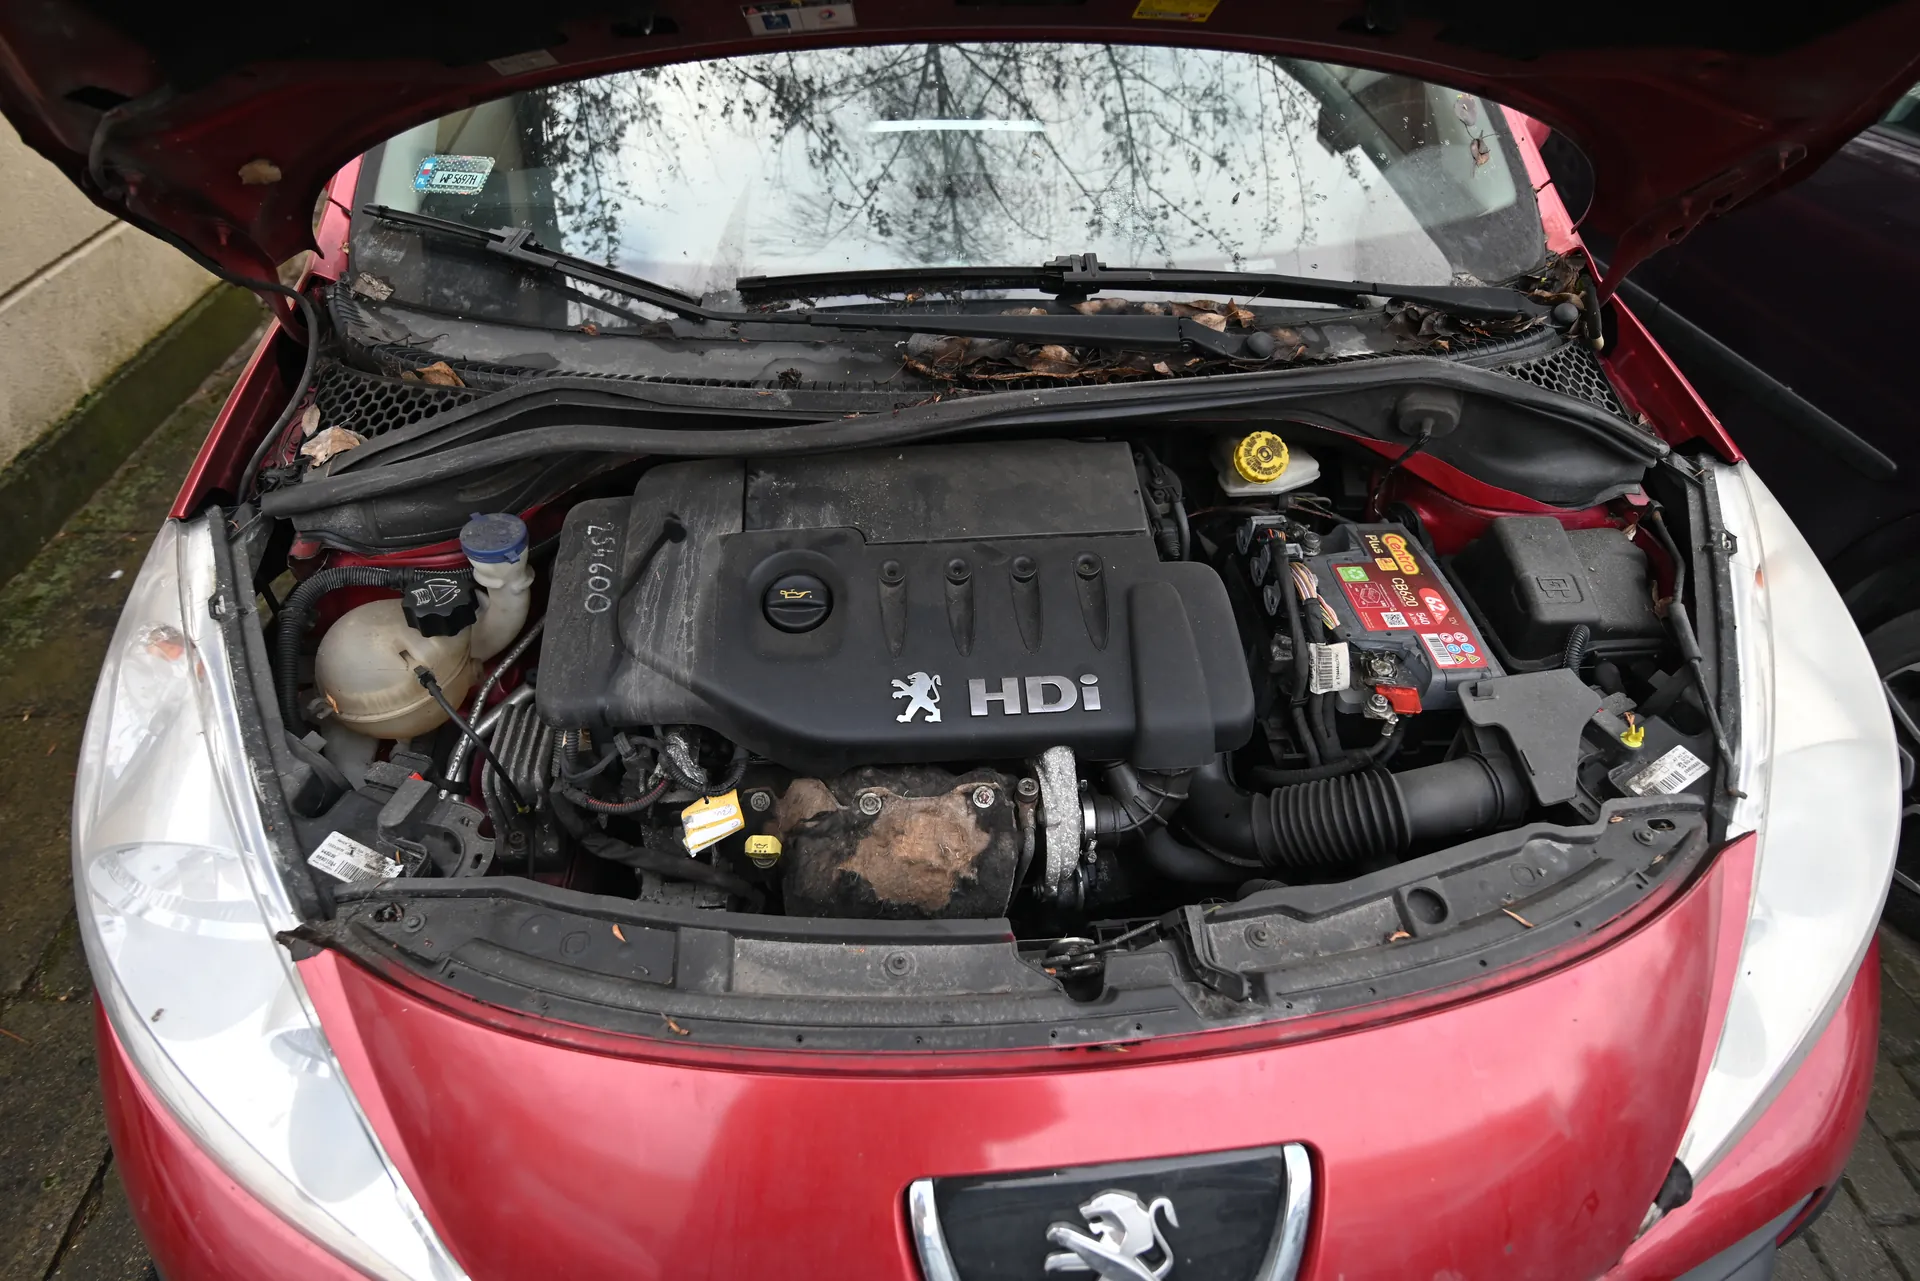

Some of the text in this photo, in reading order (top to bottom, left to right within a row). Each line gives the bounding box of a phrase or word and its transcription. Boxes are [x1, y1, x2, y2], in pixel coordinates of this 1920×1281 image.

[439, 173, 453, 184] WP
[1365, 534, 1383, 554] Plus
[1391, 577, 1418, 607] CB620
[1424, 596, 1446, 612] 62
[1416, 612, 1430, 625] 540
[968, 673, 1101, 716] HDi
